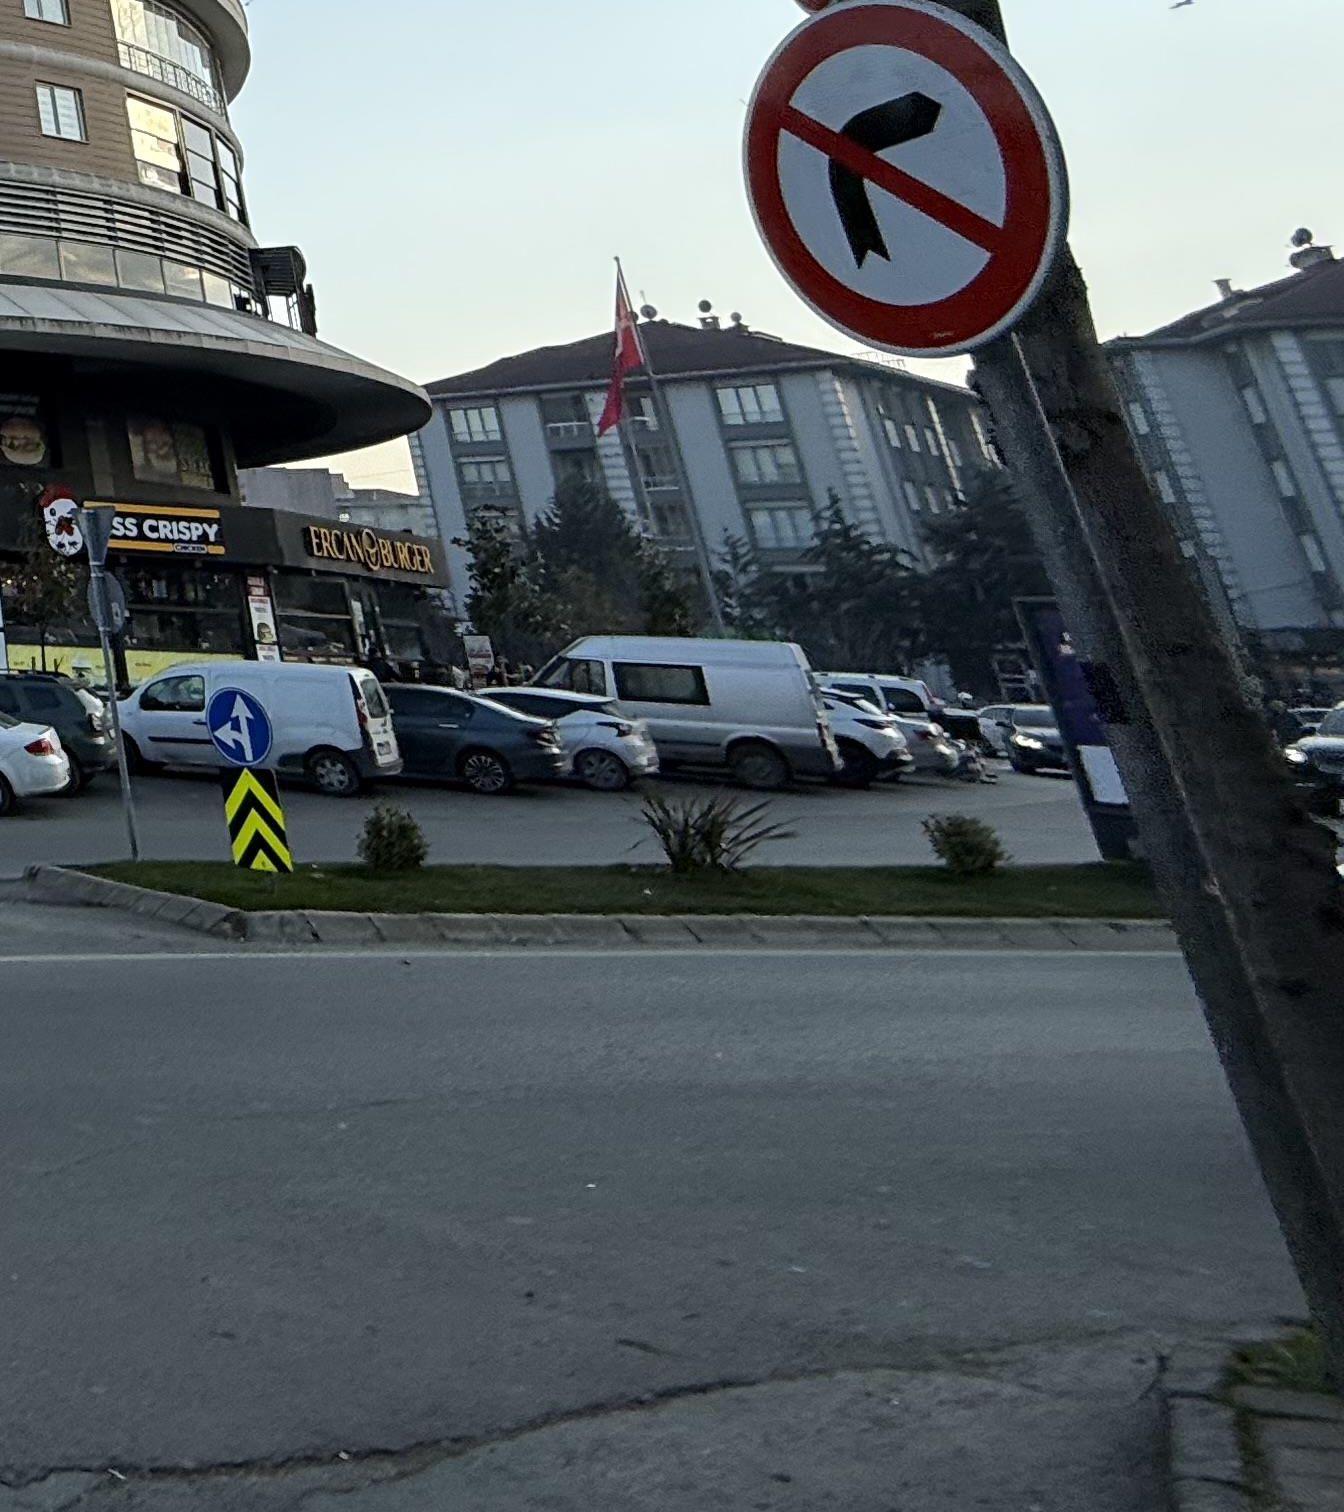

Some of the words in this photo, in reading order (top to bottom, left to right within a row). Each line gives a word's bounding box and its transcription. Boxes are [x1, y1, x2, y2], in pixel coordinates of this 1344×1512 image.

[110, 516, 139, 538] SS
[142, 518, 219, 543] CRISPY
[308, 525, 365, 563] ERCAN
[377, 538, 435, 574] BURGER
